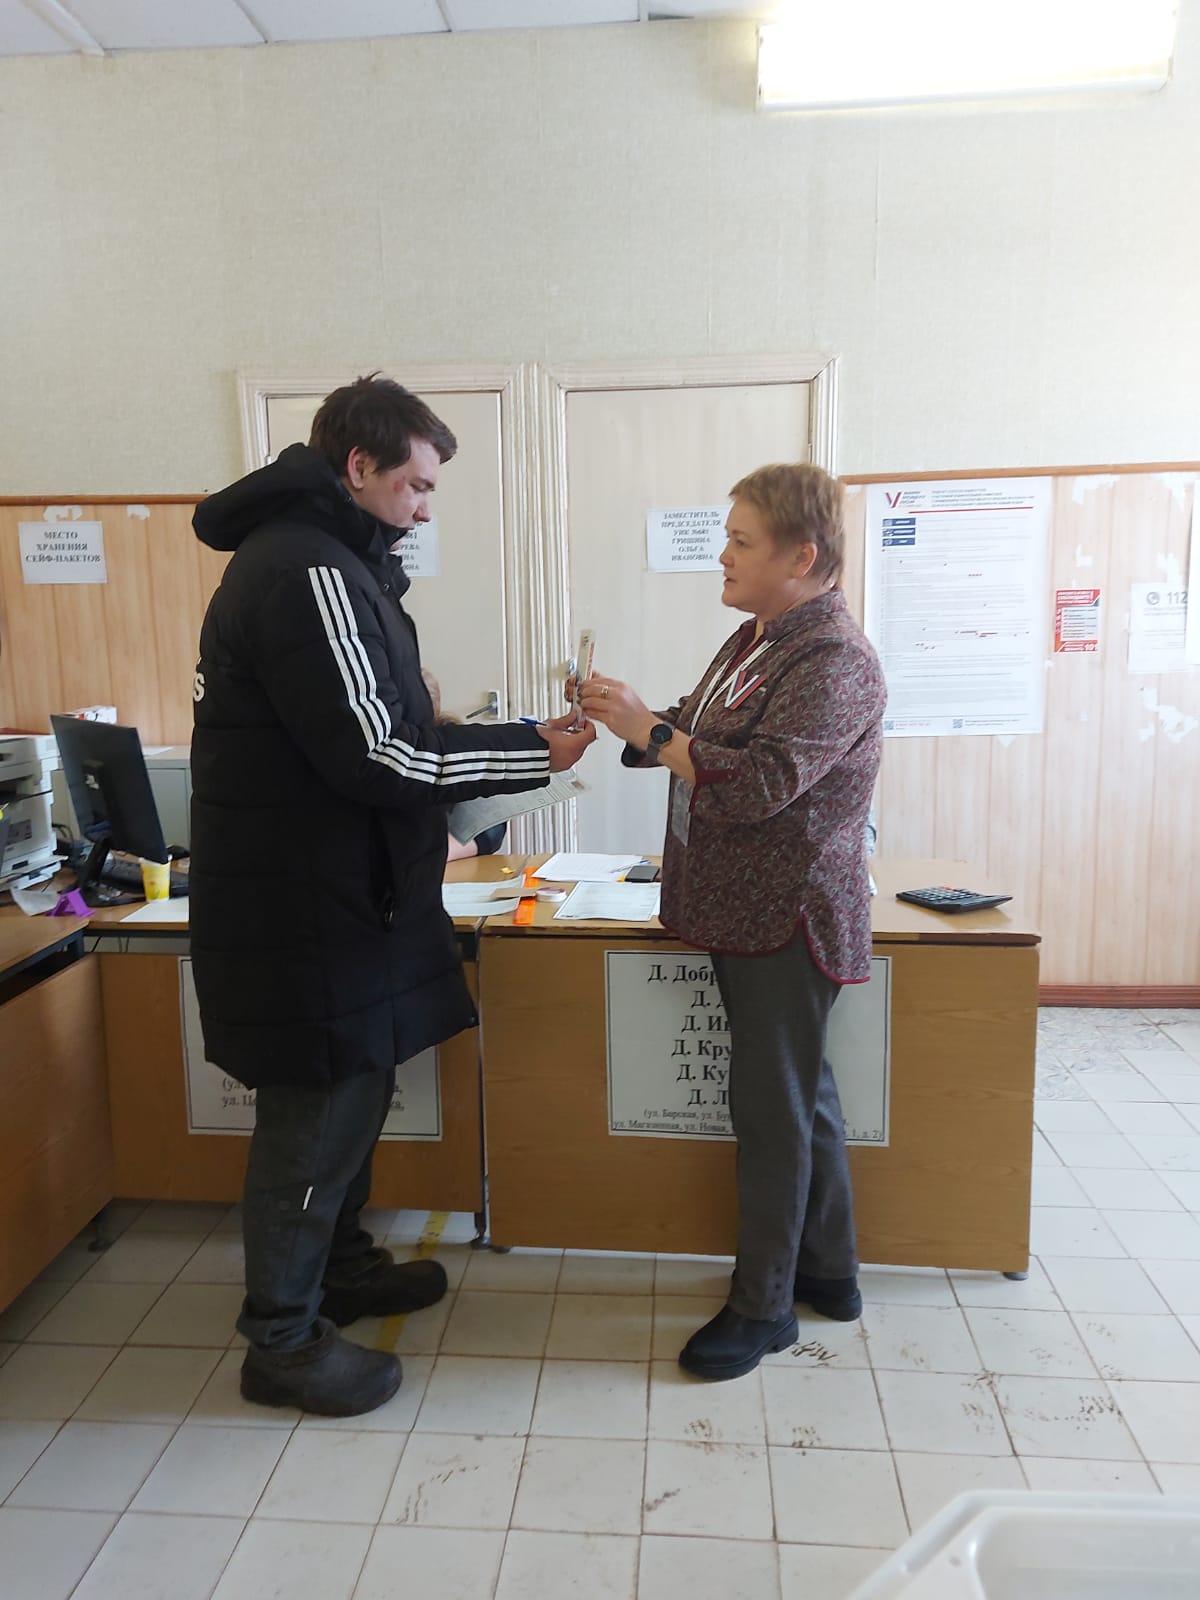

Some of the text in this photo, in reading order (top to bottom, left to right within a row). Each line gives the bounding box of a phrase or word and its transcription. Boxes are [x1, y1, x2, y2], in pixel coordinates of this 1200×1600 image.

[44, 531, 78, 539] МЕСТО
[36, 543, 88, 551] ХРАНЕНИЯ
[25, 553, 102, 562] СЕЙФ-ПАКЕТОВ
[1167, 591, 1188, 605] 112
[647, 964, 717, 986] Д. Добр
[690, 990, 711, 1008] Д.
[681, 1015, 701, 1033] Д.
[671, 1039, 732, 1060] Д. Кру
[676, 1063, 728, 1085] Д. Ку
[687, 1088, 729, 1106] Д. Л
